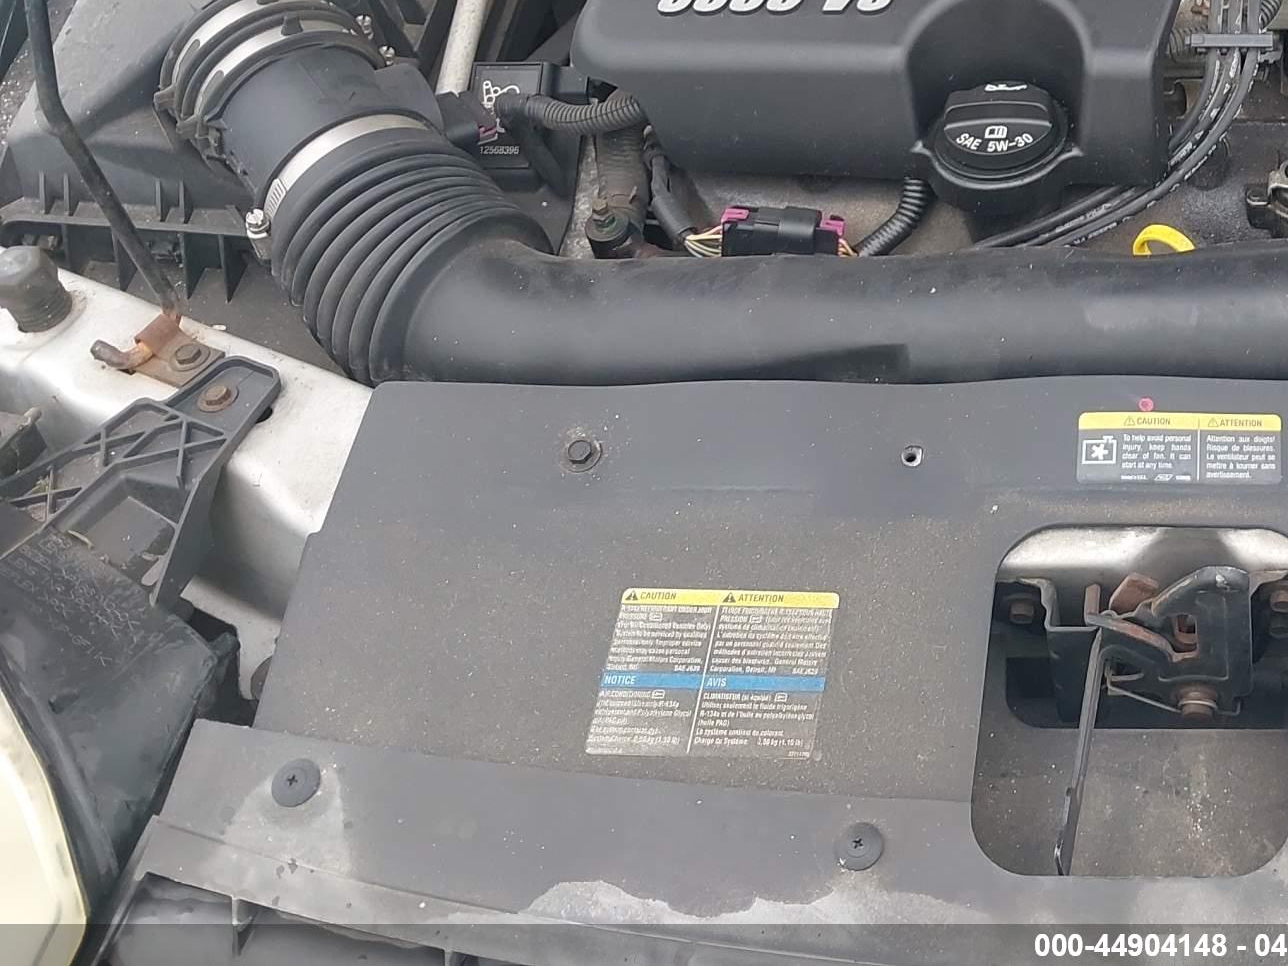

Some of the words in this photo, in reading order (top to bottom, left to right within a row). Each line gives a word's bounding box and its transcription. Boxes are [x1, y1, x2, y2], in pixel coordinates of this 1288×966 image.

[956, 133, 982, 150] SAE
[987, 133, 1034, 152] 5W-30
[1220, 419, 1262, 427] ATTENTION
[1132, 434, 1145, 442] help
[1149, 443, 1165, 451] keep
[640, 592, 676, 600] CAUTION
[738, 594, 784, 603] ATTENTION
[604, 676, 637, 684] NOTICE
[706, 678, 727, 687] AVIS
